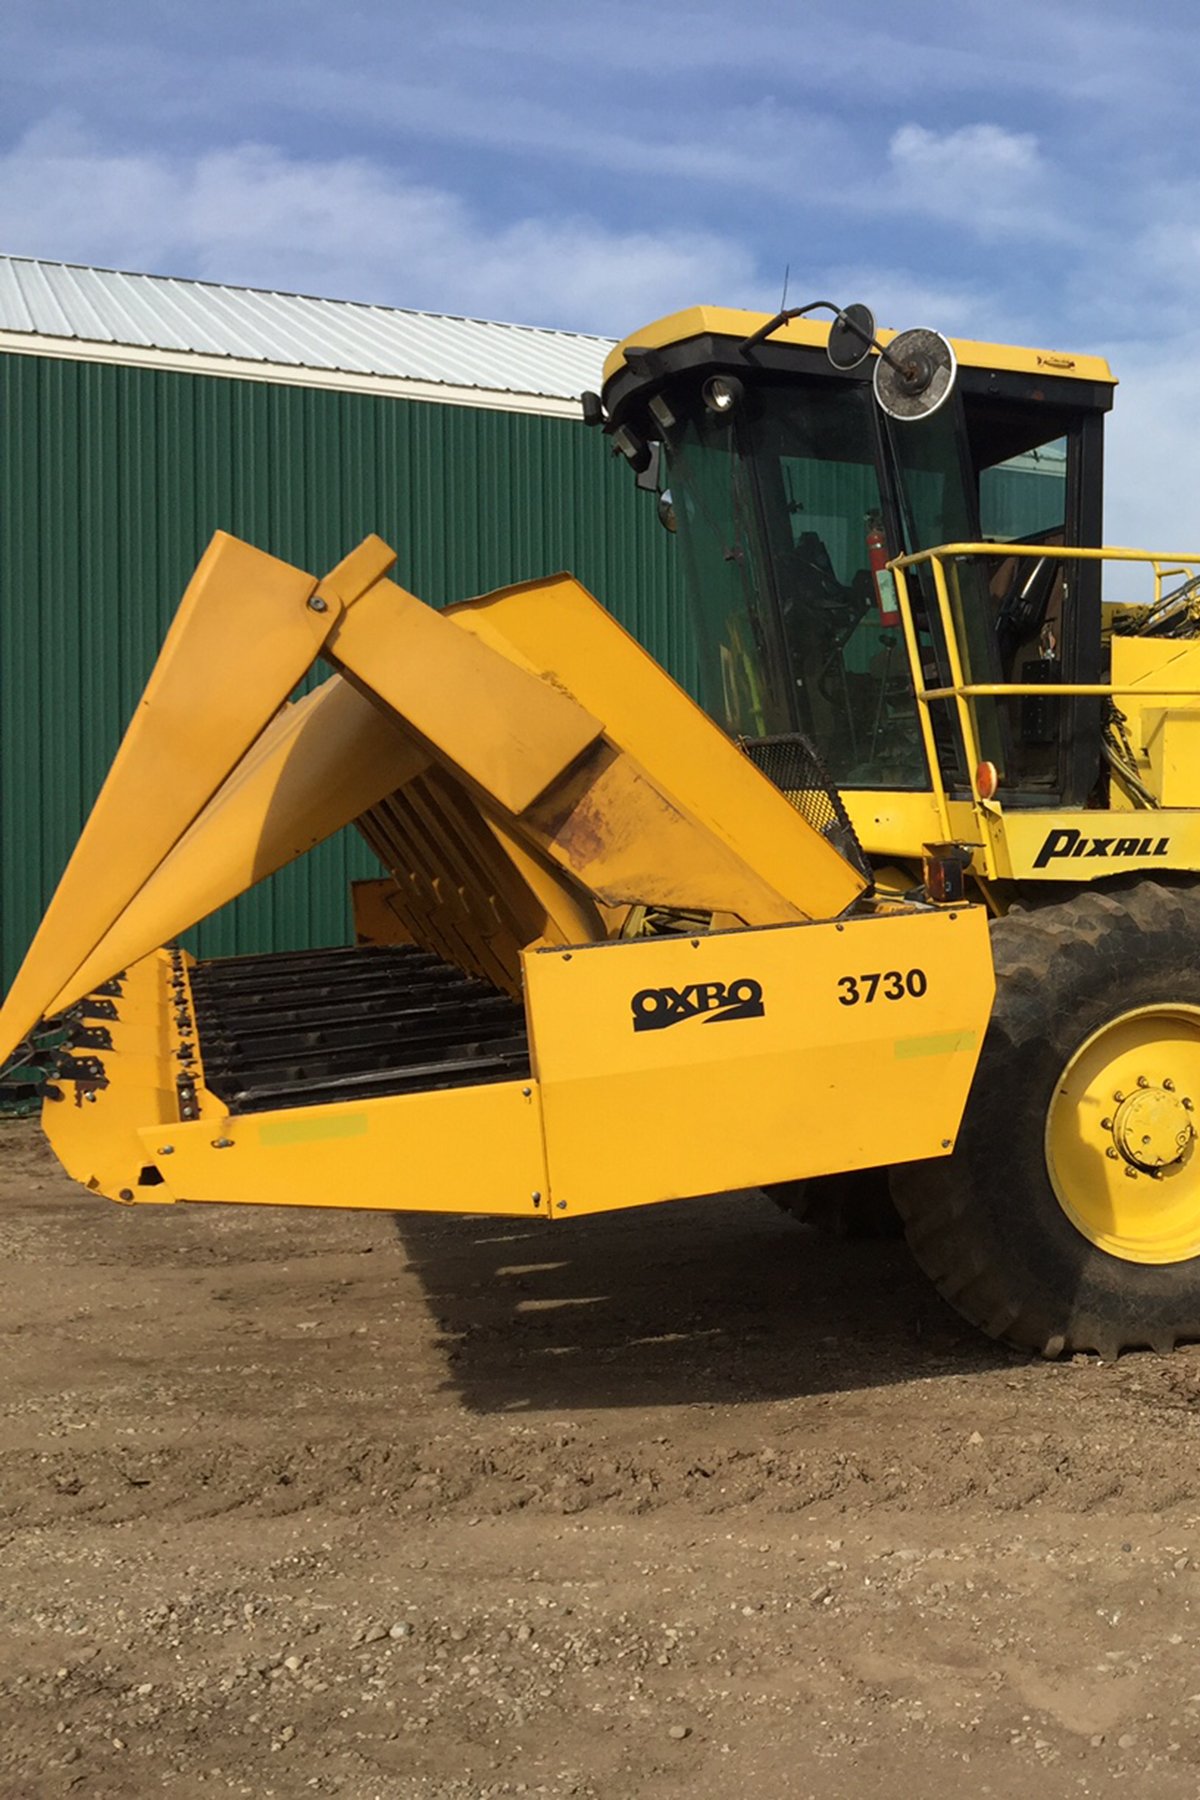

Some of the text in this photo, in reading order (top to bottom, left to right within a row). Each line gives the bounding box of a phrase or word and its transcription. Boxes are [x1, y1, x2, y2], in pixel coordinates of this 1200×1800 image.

[1032, 829, 1170, 868] PIXALL
[631, 978, 765, 1032] OXBO
[837, 968, 928, 1006] 3730
